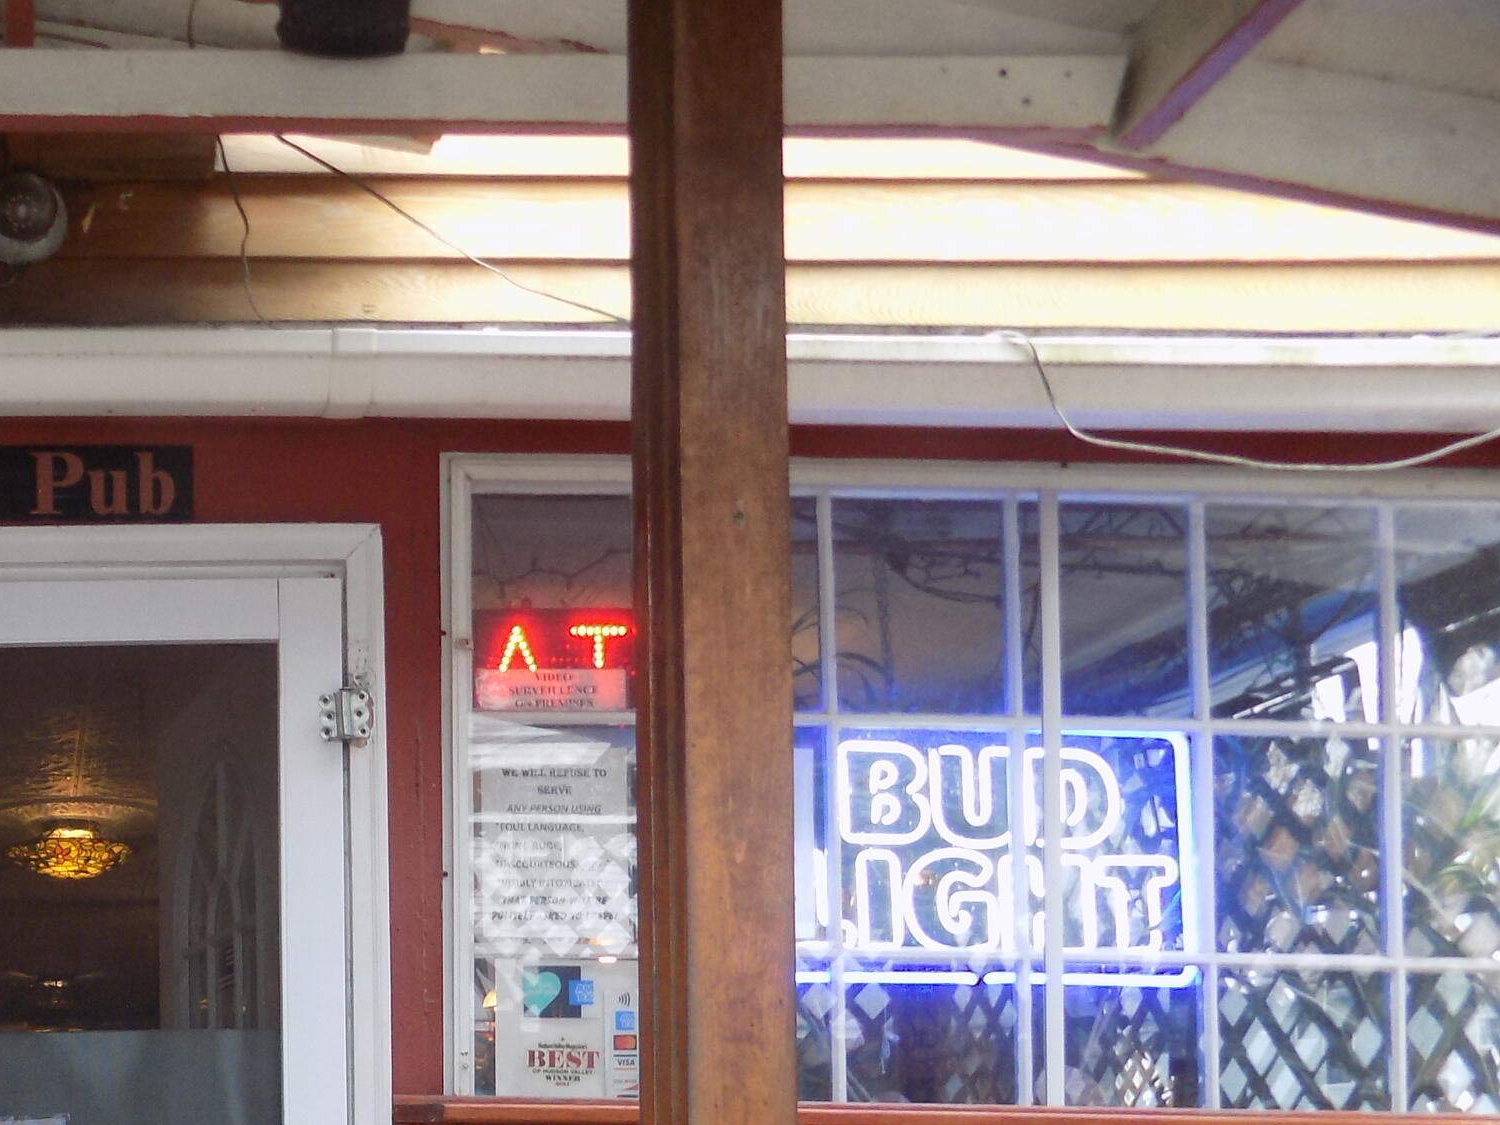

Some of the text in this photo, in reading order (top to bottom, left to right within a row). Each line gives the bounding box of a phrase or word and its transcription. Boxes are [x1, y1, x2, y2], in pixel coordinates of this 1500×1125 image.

[28, 452, 175, 515] Pub
[534, 672, 572, 681] VIDEO
[502, 768, 607, 777] WE WILL REFUSE TO
[537, 785, 572, 794] SERVE
[837, 740, 1122, 850] BUD
[507, 804, 601, 813] ANY PERSON USING
[527, 1050, 599, 1069] BEST
